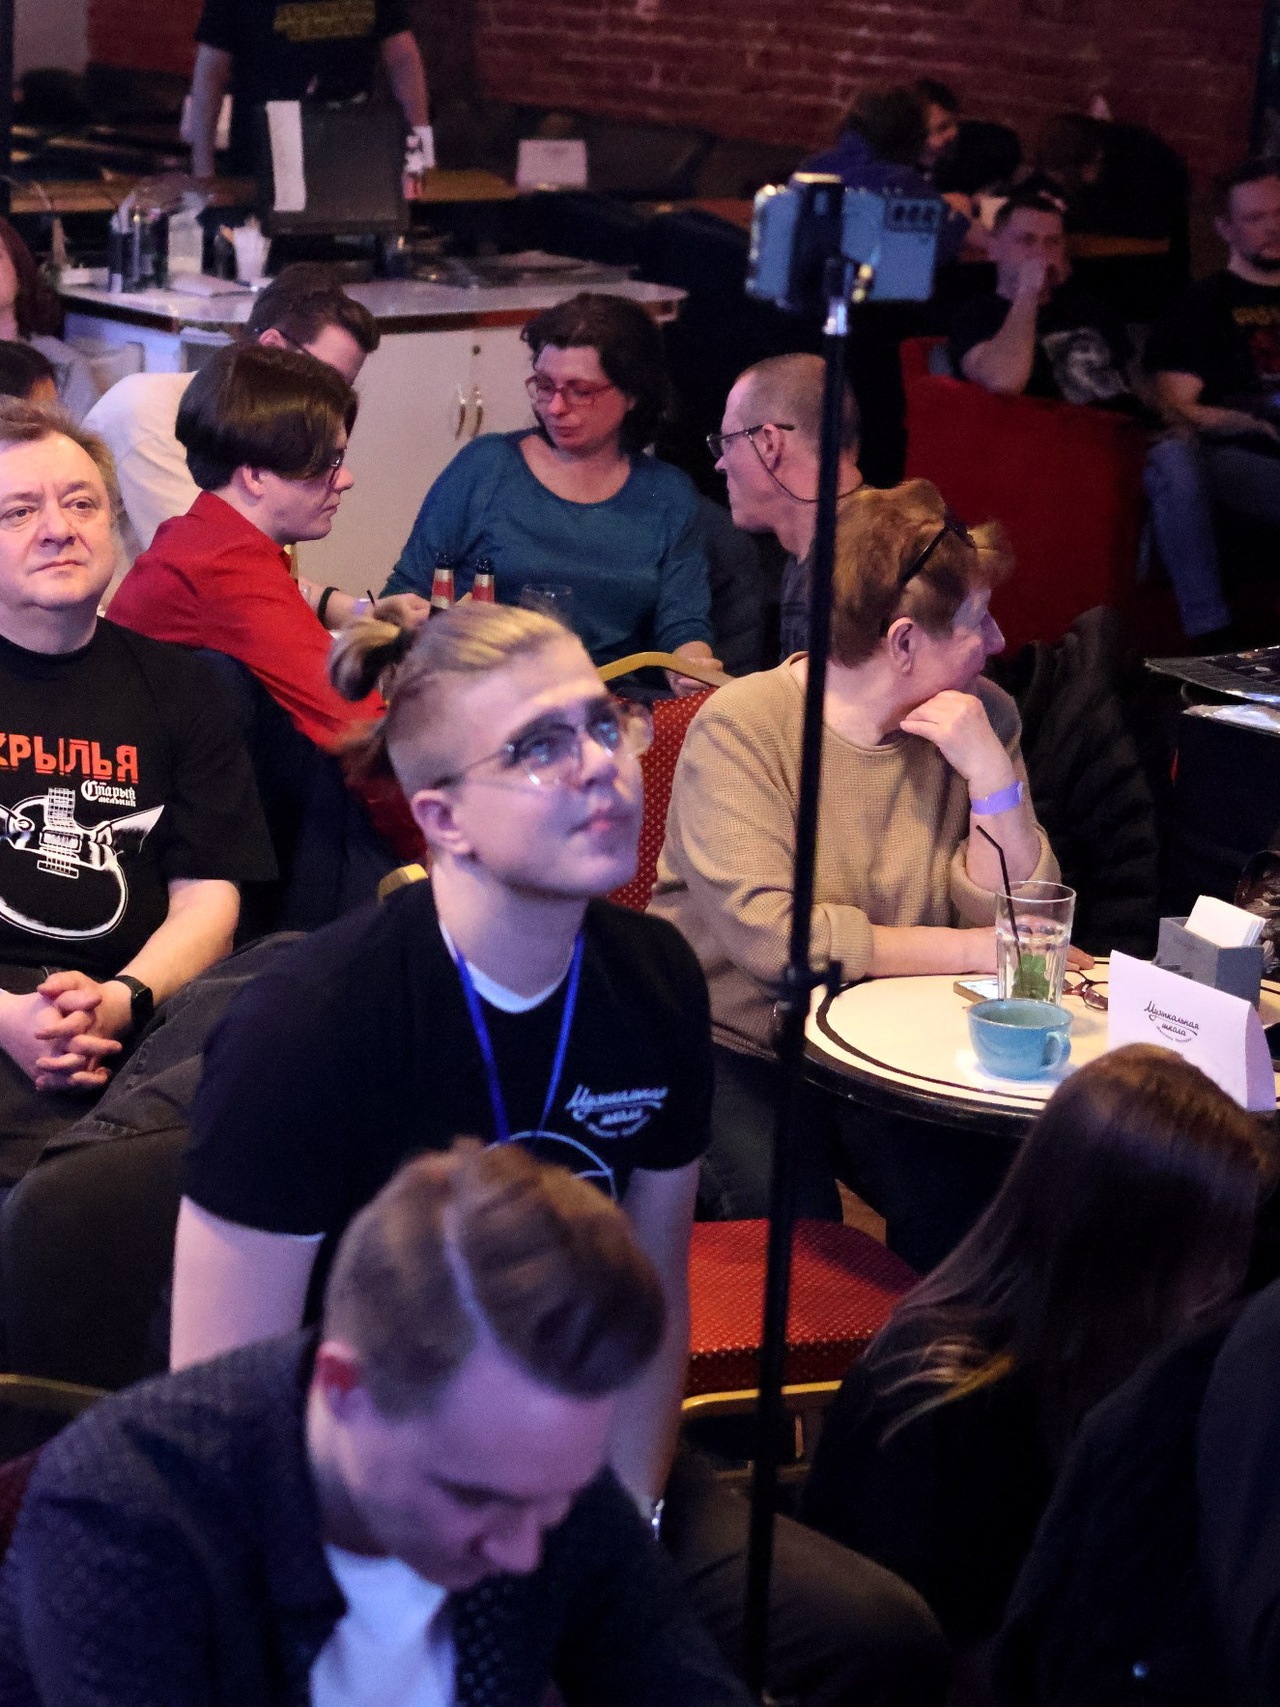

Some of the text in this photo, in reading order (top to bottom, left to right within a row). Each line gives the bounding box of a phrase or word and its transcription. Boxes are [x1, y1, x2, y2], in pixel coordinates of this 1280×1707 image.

[80, 779, 136, 801] Старый
[1143, 1000, 1200, 1031] Музыкальная
[1161, 1022, 1187, 1037] школа
